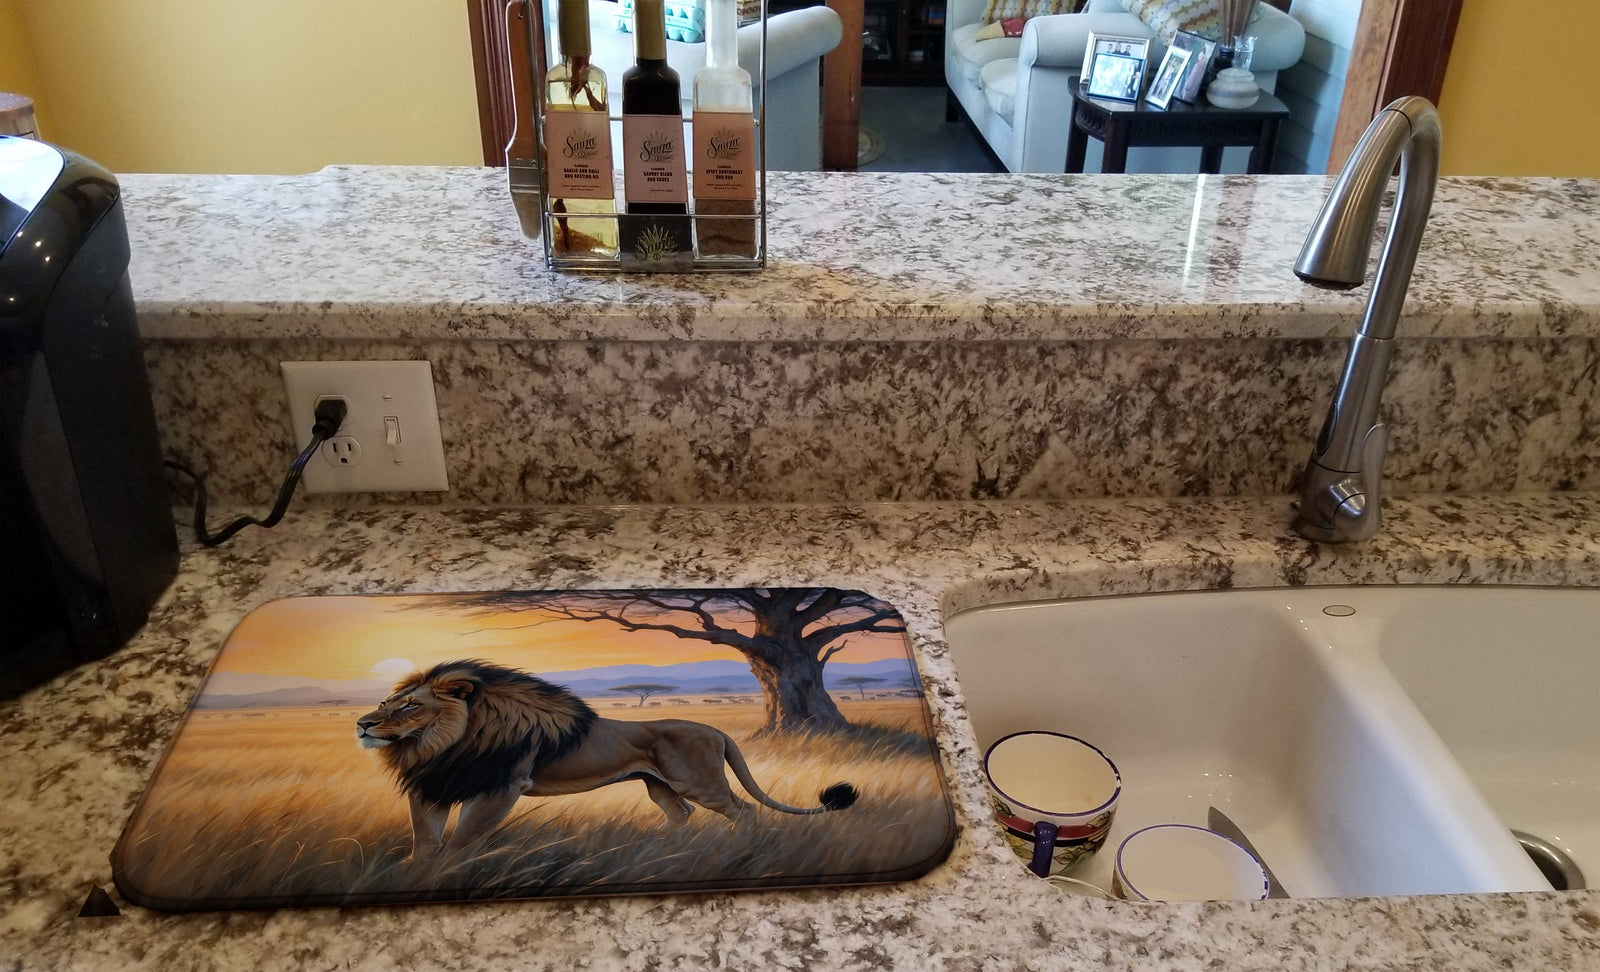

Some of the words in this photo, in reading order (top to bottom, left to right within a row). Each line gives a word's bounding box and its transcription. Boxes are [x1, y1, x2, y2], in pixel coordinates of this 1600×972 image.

[562, 136, 597, 158] Sauza
[639, 140, 673, 162] Sauza
[706, 137, 739, 159] Sauza
